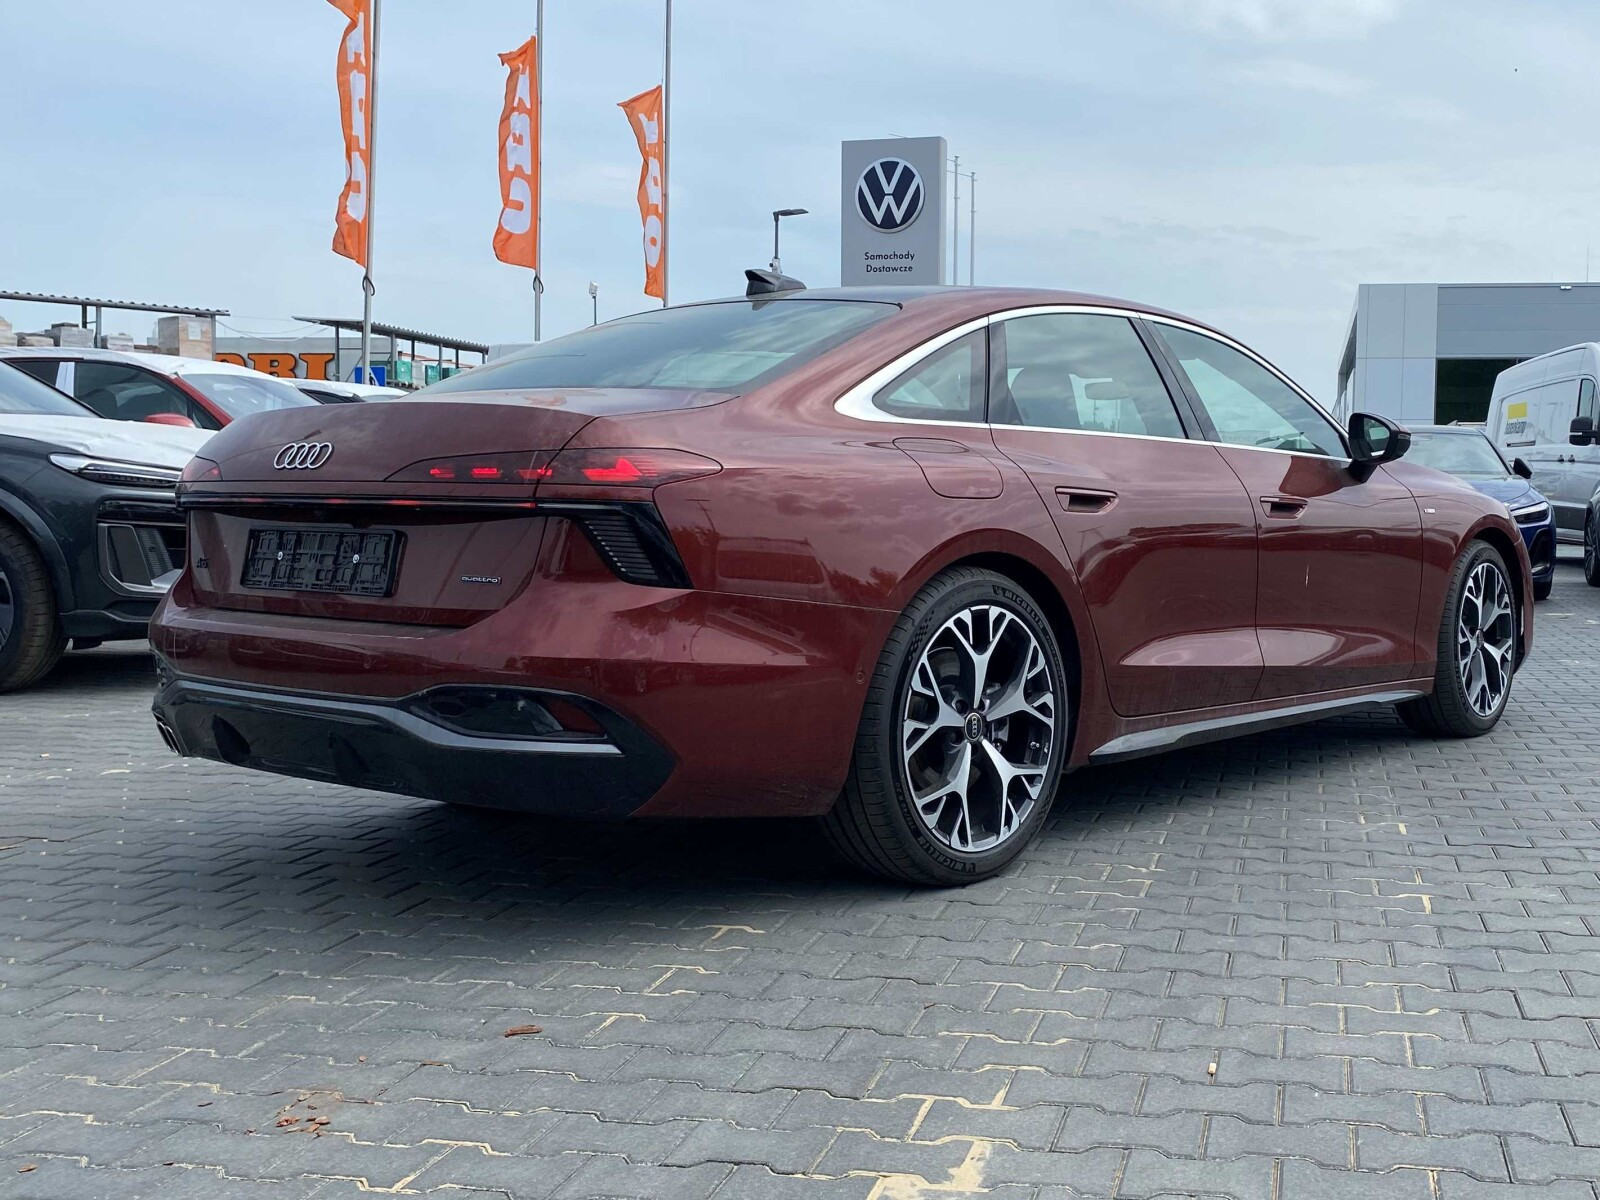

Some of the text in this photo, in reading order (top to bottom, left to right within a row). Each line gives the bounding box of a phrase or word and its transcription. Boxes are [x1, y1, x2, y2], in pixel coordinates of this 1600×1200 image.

[864, 251, 915, 261] Samochody
[866, 264, 914, 273] Dostawcze
[461, 576, 498, 584] quattro
[1004, 591, 1045, 630] MICHELIN
[917, 835, 964, 872] MICHELIN
